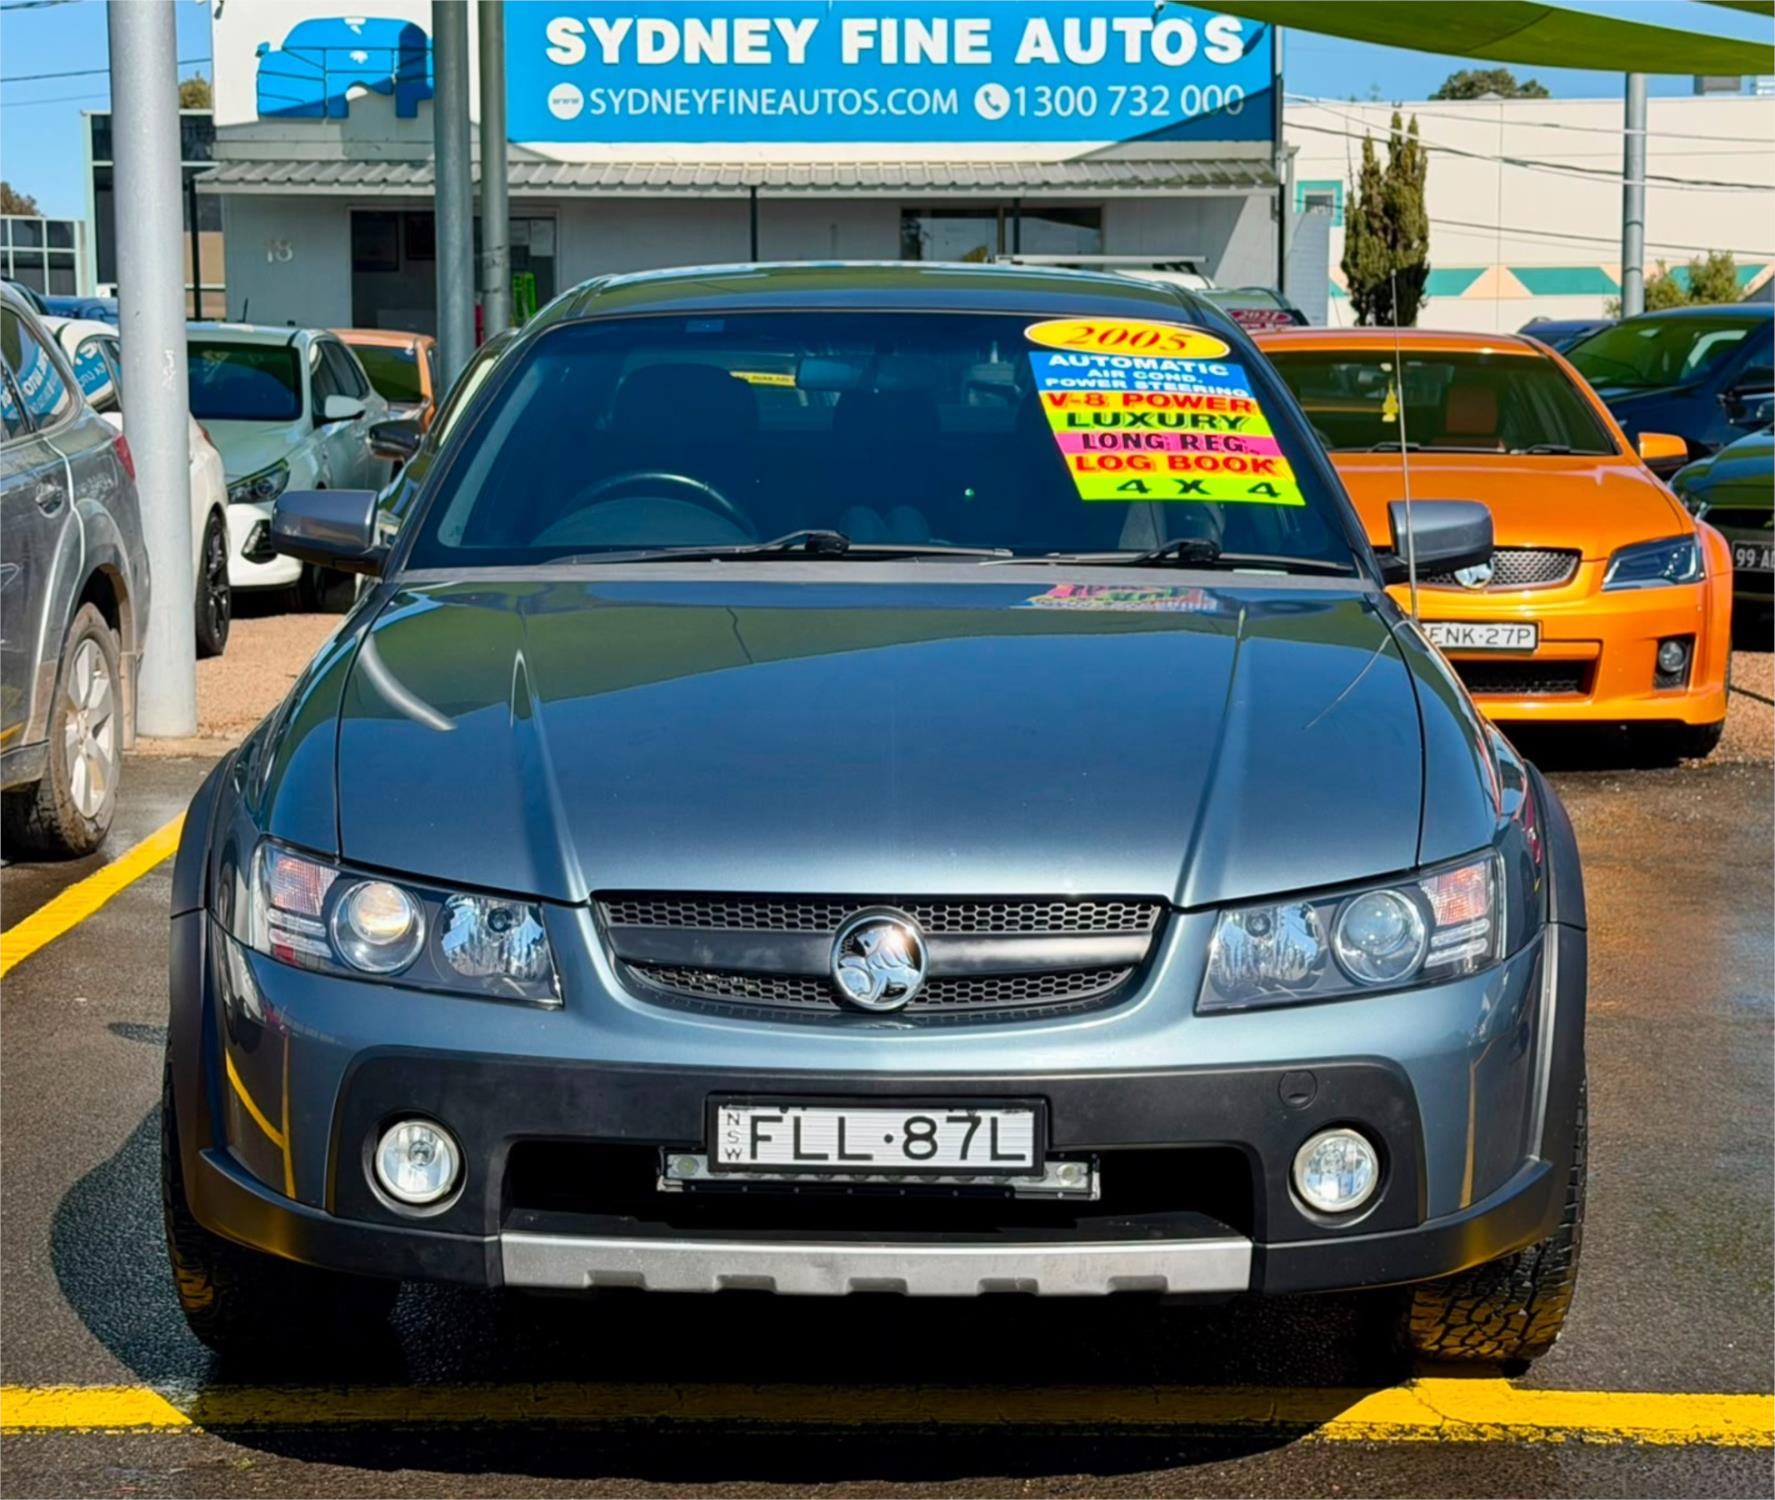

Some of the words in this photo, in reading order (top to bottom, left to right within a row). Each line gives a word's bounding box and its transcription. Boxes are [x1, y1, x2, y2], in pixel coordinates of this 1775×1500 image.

[546, 17, 818, 65] SYDNEY
[841, 18, 990, 64] FINE
[1014, 14, 1246, 67] AUTOS
[590, 87, 958, 116] SYDNEYFINEAUTOS.COM
[1014, 86, 1097, 116] 1300
[1109, 86, 1169, 116] 732
[1180, 84, 1245, 116] 000
[1064, 326, 1193, 351] 2005
[1049, 354, 1230, 376] AUTOMATIC
[1087, 369, 1126, 379] AIR
[1132, 371, 1203, 383] COND.
[1045, 378, 1127, 389] POWER
[1134, 382, 1249, 397] STEERING
[1048, 393, 1105, 407] V-8
[1122, 393, 1252, 412] POWER
[1067, 412, 1248, 429] LUXURY
[1083, 433, 1170, 450] LONG
[1076, 455, 1152, 472] LOG
[1168, 455, 1277, 474] BOOK
[1117, 480, 1152, 494] 4
[1174, 479, 1212, 495] X
[1248, 482, 1281, 498] 4
